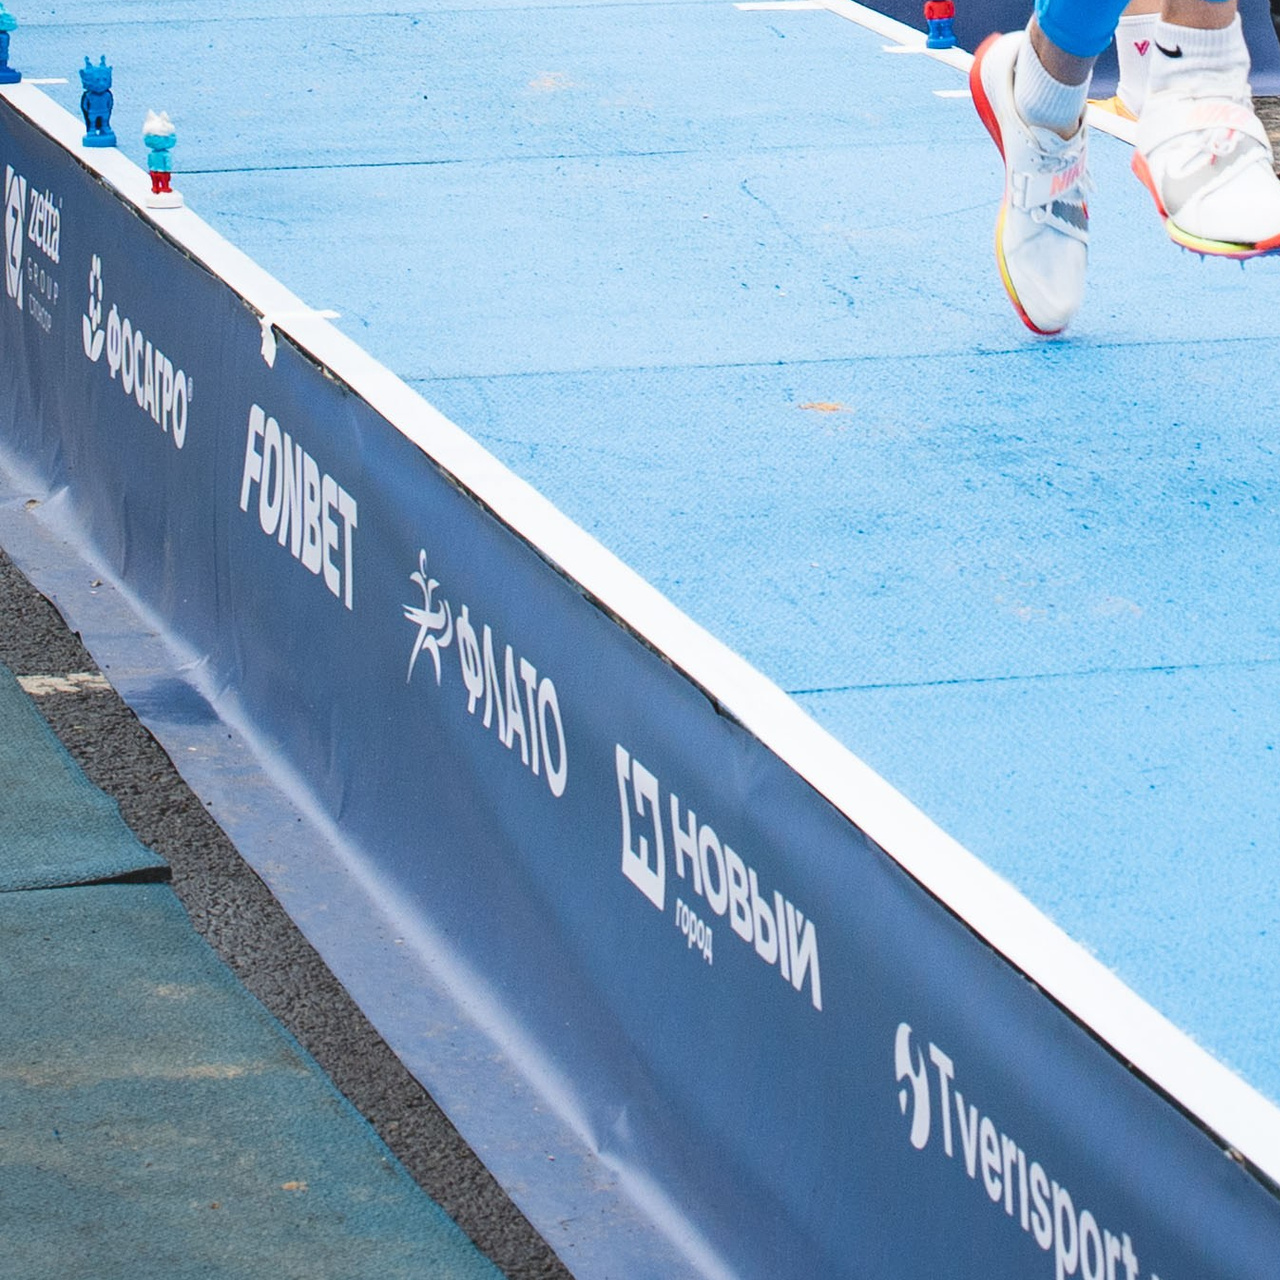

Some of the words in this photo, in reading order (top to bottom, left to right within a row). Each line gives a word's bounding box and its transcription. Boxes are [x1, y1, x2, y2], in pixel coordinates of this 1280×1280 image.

[27, 256, 59, 306] GROUP
[28, 188, 60, 264] zetta
[240, 403, 358, 610] FONBET
[457, 604, 567, 798] ФЛАТО
[670, 792, 823, 1012] НОВЫЙ
[675, 897, 713, 966] город
